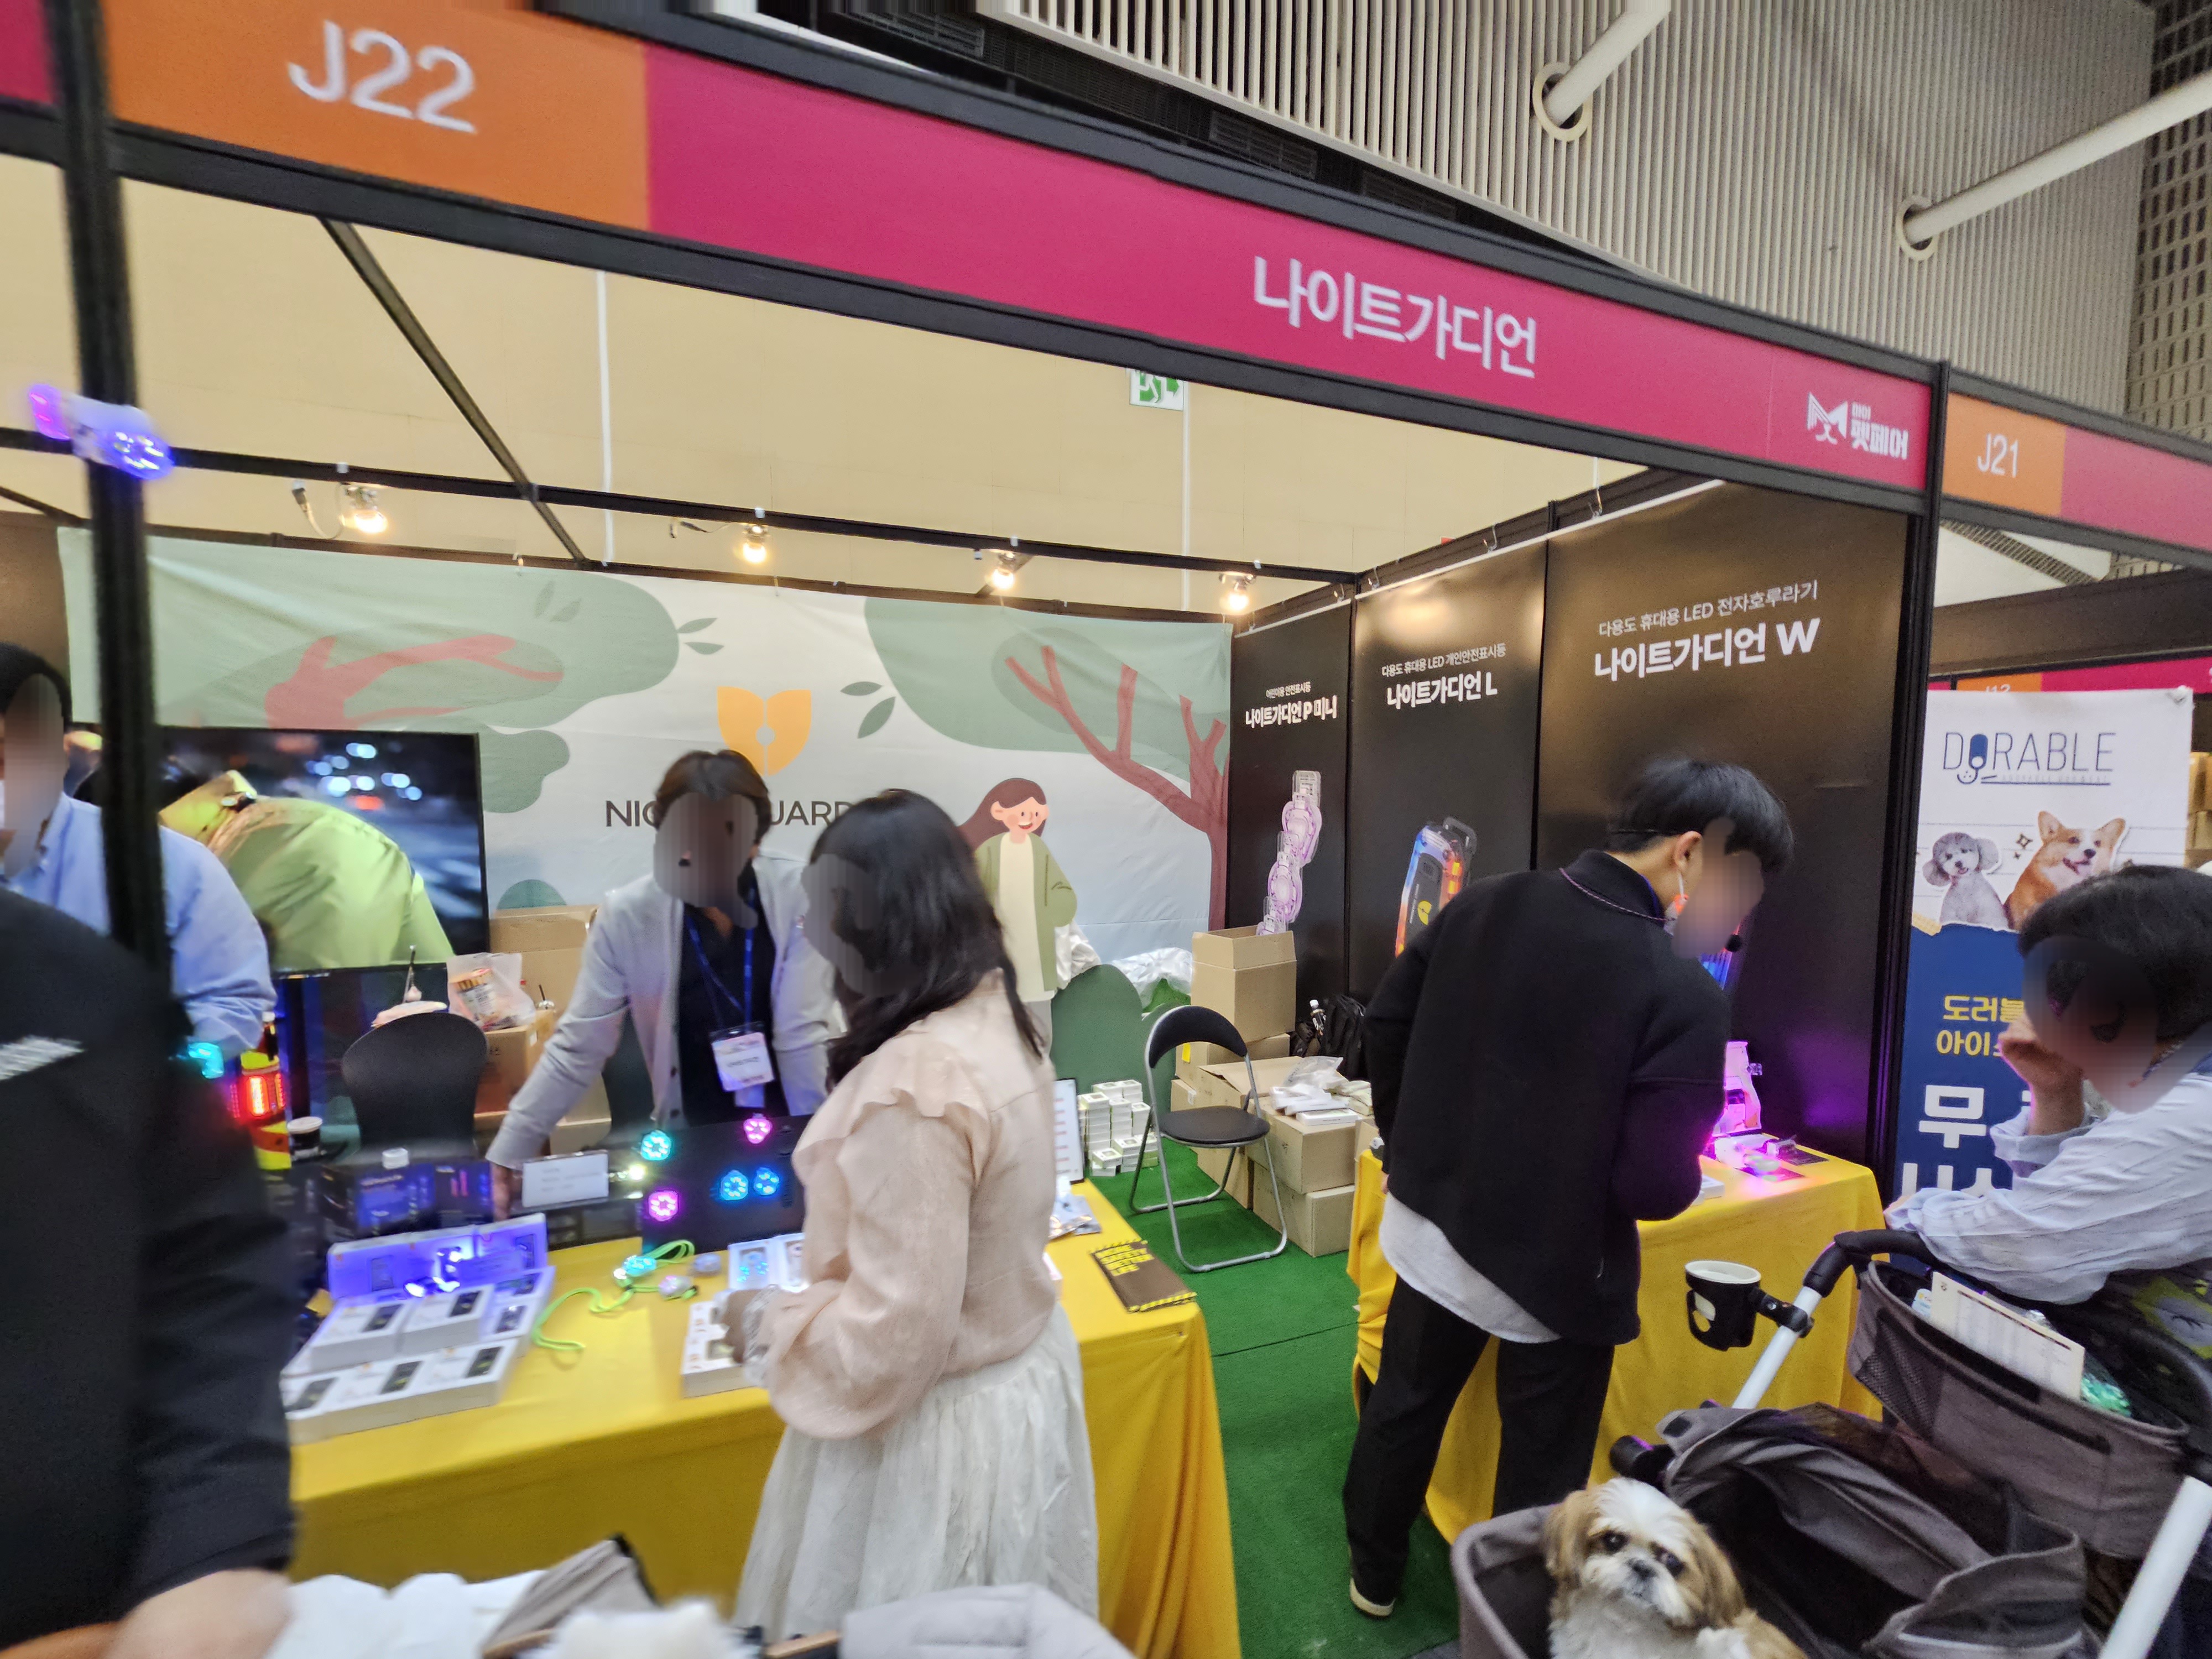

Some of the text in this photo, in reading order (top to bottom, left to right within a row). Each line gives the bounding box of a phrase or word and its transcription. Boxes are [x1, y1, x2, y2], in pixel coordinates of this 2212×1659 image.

[288, 19, 476, 133] J22
[1254, 255, 1536, 378] 나이트가디언
[1851, 419, 1908, 460] 펫페어
[1977, 433, 2018, 478] J21
[1599, 579, 1818, 637] 다용도 휴대용 LED 전자호루라기
[1381, 663, 1404, 678] 다용도
[1404, 658, 1427, 674] 휴대용
[1427, 655, 1445, 669] LED
[1595, 617, 1820, 682] 나이트가디언 W
[1245, 701, 1302, 728] 나이트가디언
[1313, 694, 1337, 721] 미니
[1386, 670, 1498, 709] 나이트가디언 L
[1943, 995, 2025, 1023] 도러블
[1937, 1030, 2004, 1057] 아이
[1919, 1085, 2031, 1148] 무
